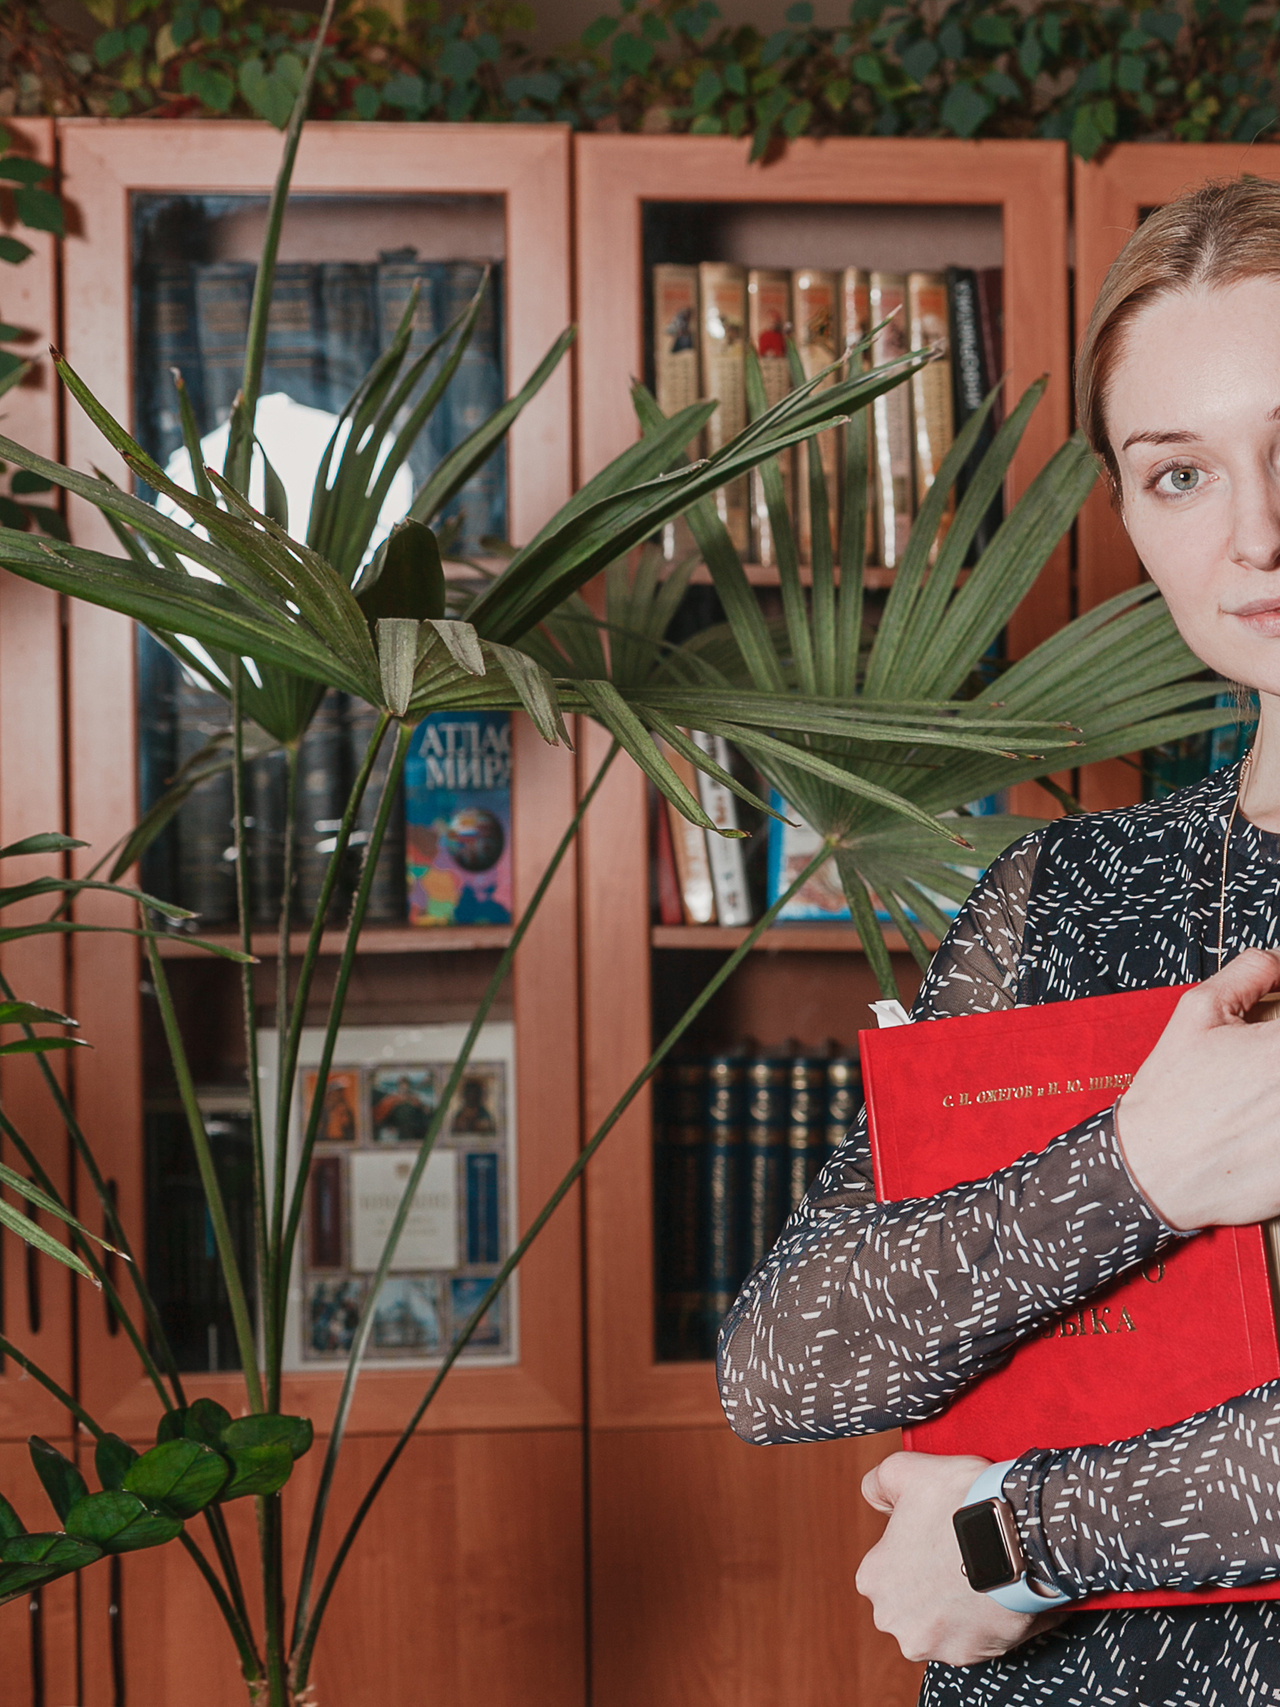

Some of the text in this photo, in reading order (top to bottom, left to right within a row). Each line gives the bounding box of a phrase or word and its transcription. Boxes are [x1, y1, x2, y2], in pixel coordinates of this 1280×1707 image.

[942, 1094, 955, 1108] С.
[958, 1092, 972, 1106] И.
[975, 1085, 1033, 1104] ОЖЕГОВ
[1047, 1081, 1061, 1096] Н.
[1065, 1079, 1084, 1094] Ю.
[1088, 1073, 1134, 1091] ШВЕД
